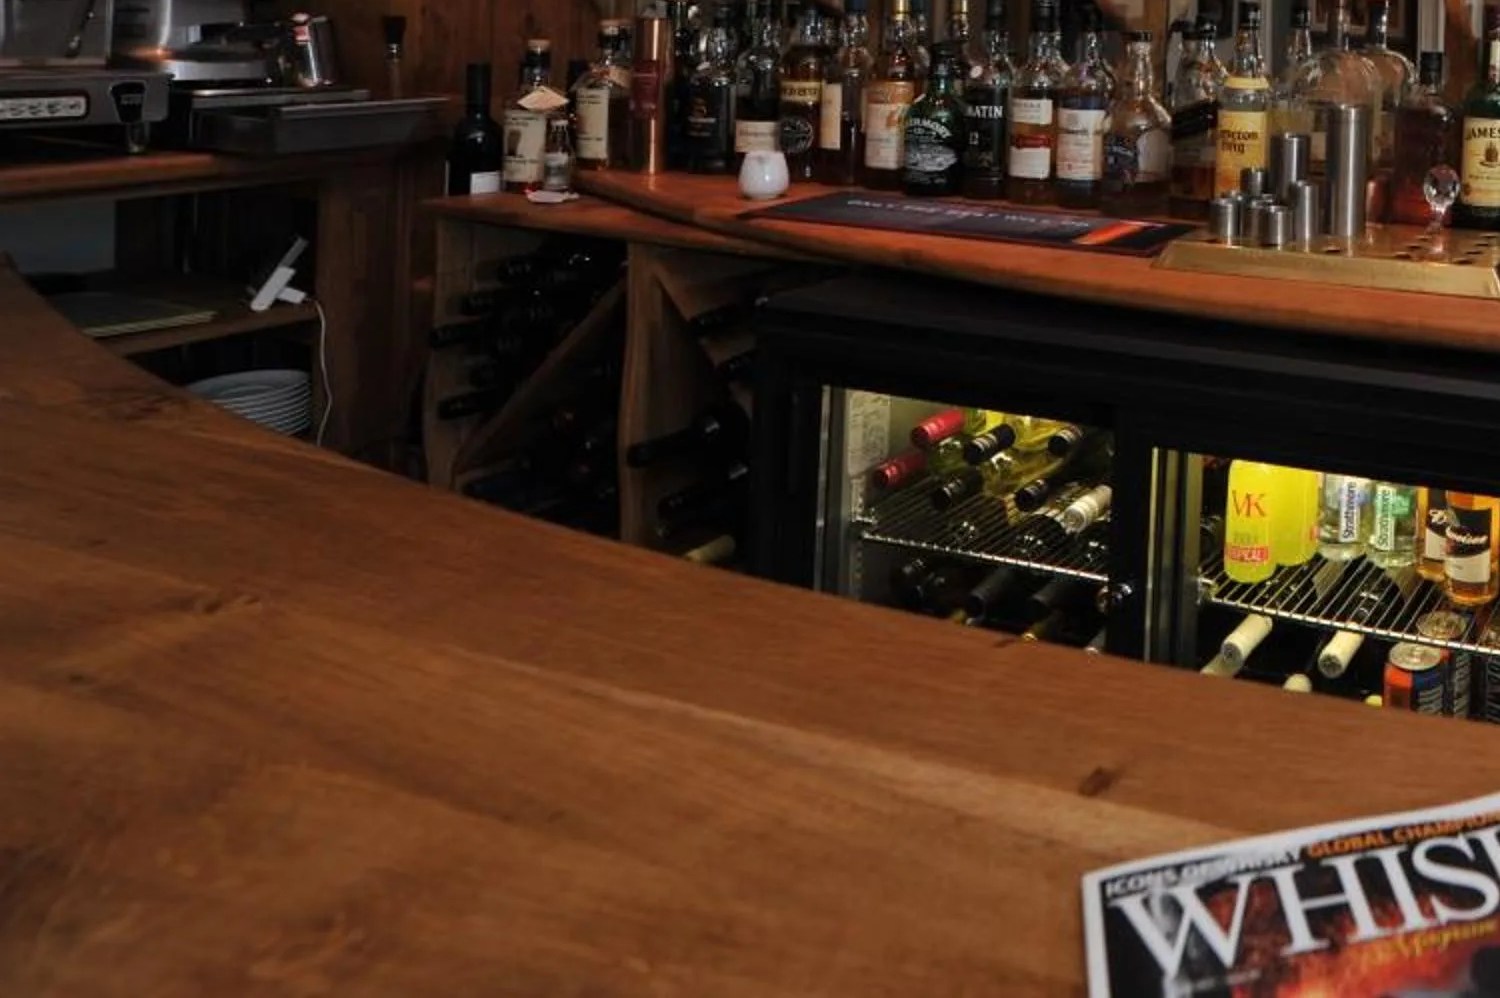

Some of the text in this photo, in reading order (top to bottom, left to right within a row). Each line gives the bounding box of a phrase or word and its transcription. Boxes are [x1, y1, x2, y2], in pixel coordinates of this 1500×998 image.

[1231, 489, 1268, 519] VK
[1376, 484, 1395, 548] Strathmore
[1308, 830, 1392, 859] GLOBAL
